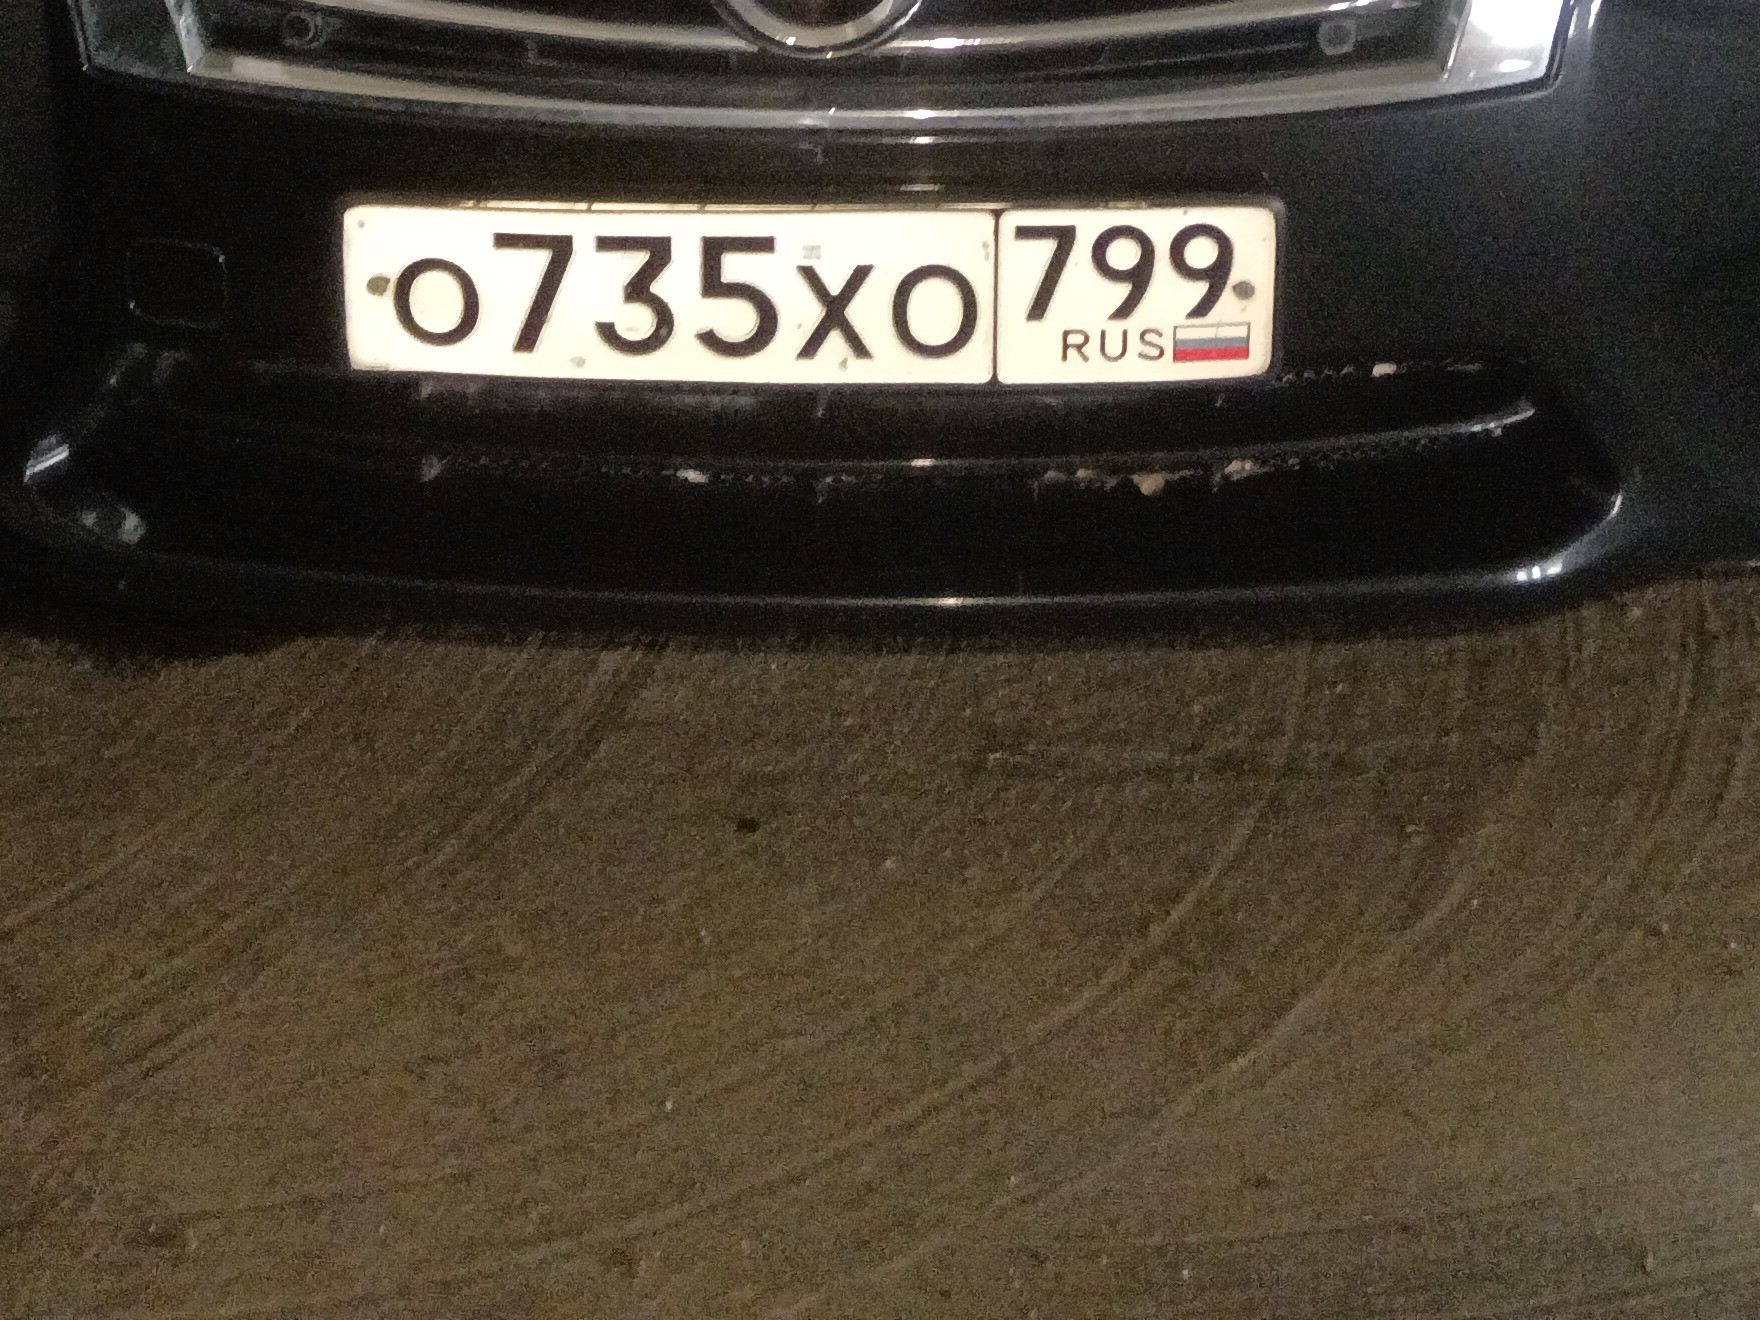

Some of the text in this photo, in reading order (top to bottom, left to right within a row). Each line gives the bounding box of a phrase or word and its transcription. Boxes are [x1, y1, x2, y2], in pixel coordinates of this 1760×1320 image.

[392, 222, 1235, 360] О735ХО 799
[1061, 328, 1166, 363] RUS
